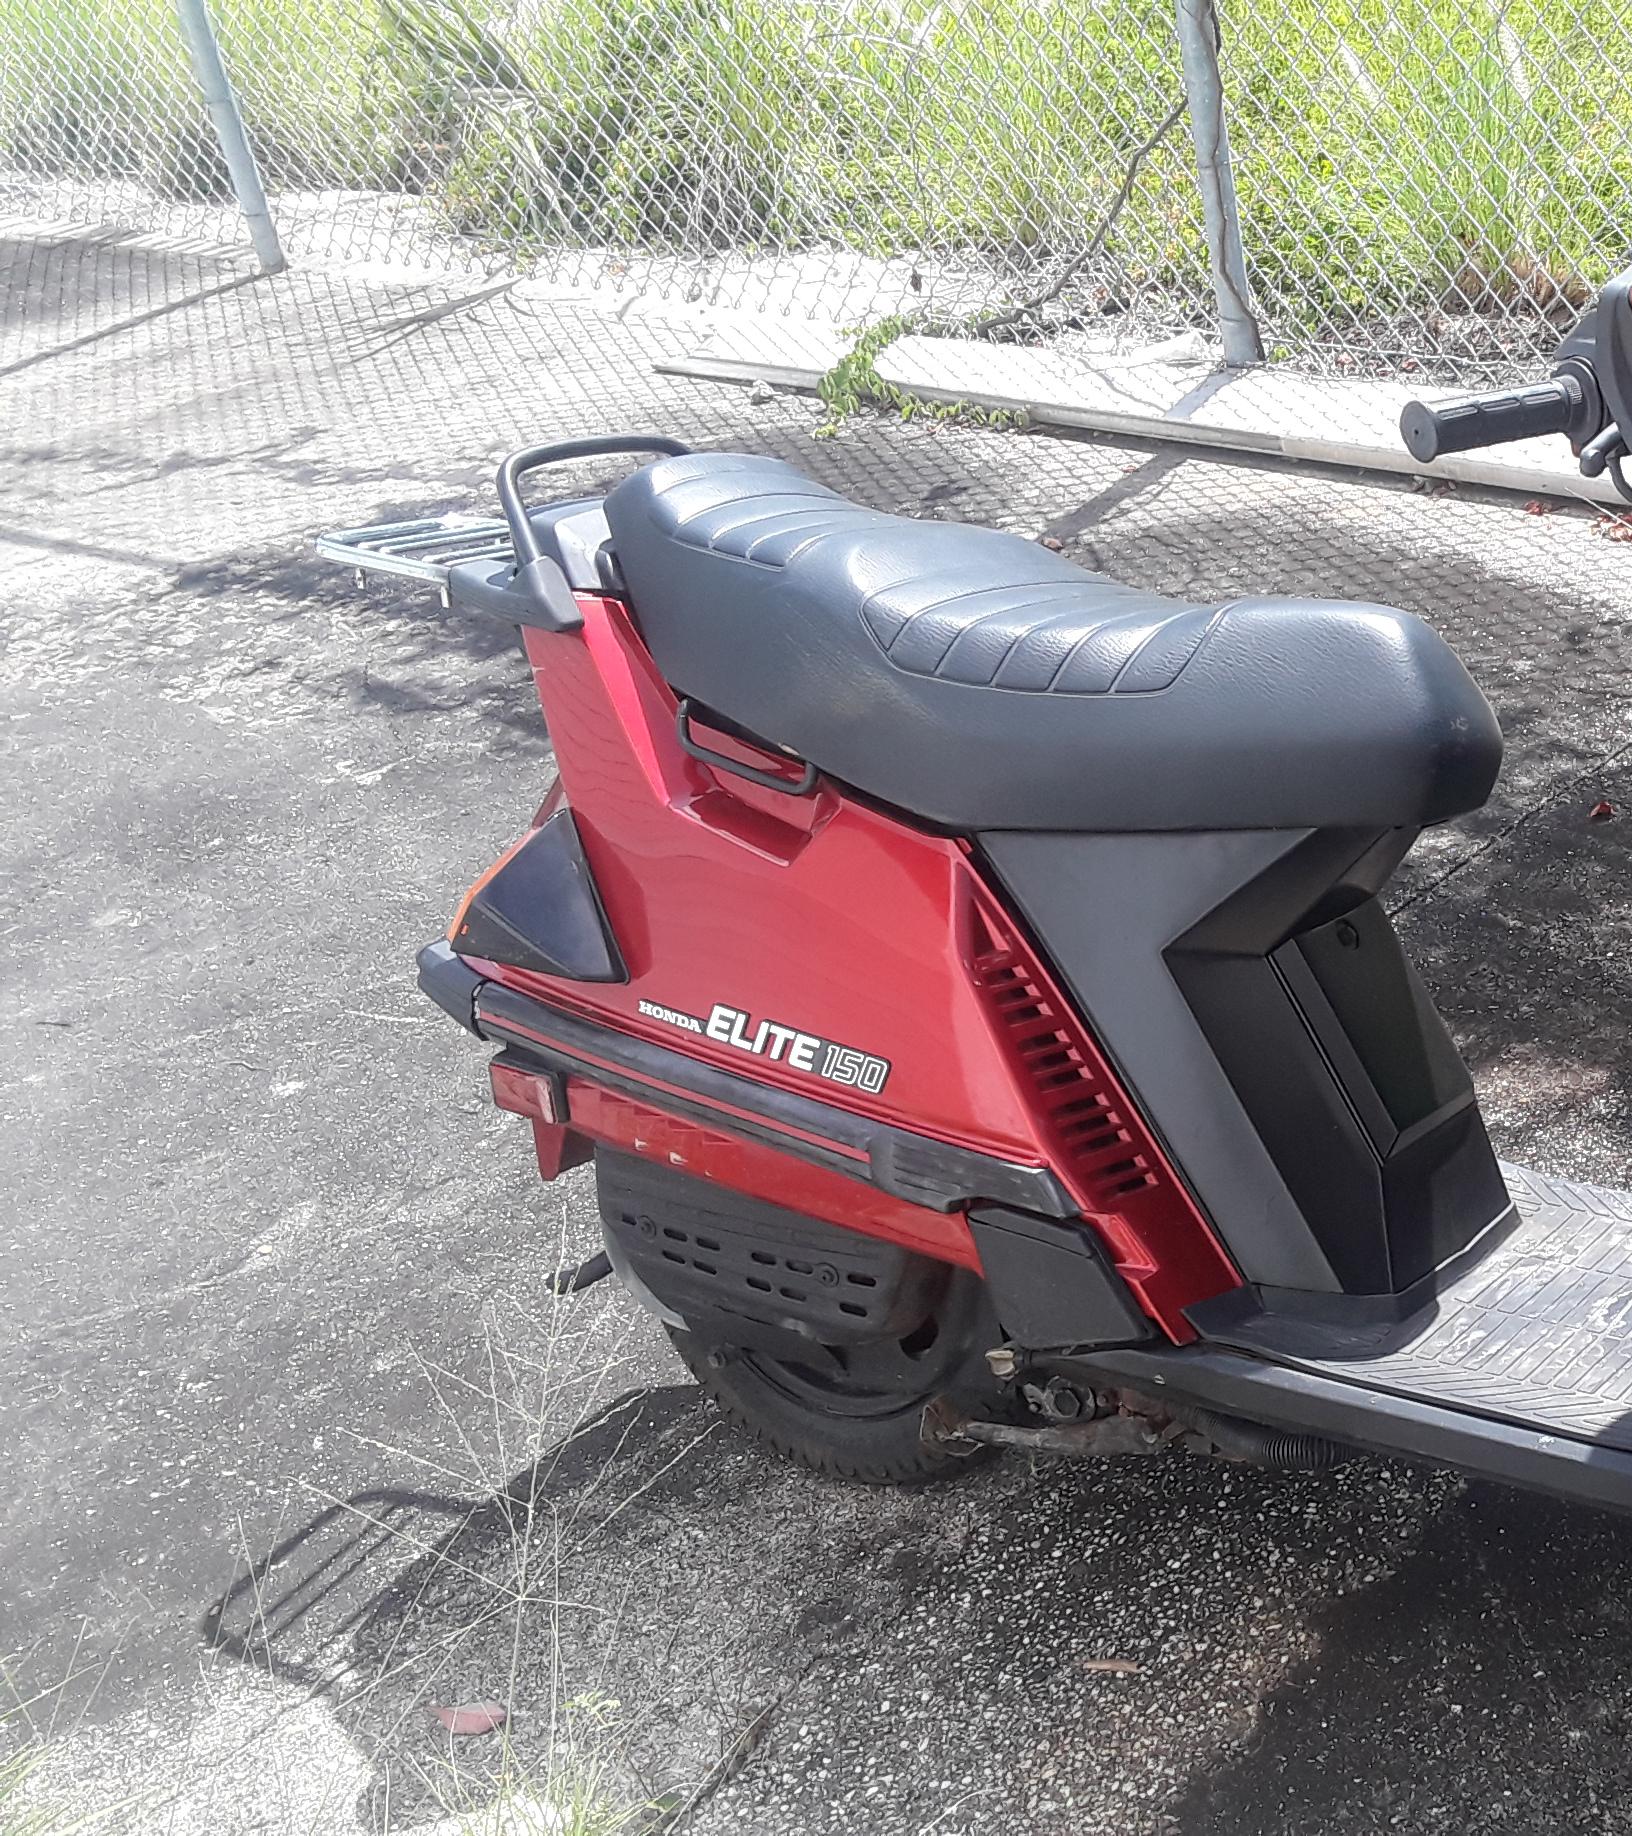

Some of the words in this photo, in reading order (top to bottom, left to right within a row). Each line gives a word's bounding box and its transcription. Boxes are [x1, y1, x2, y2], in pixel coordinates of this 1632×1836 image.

[638, 1000, 702, 1034] HONDA
[706, 1004, 821, 1072] ELITE
[821, 1044, 890, 1095] 150
